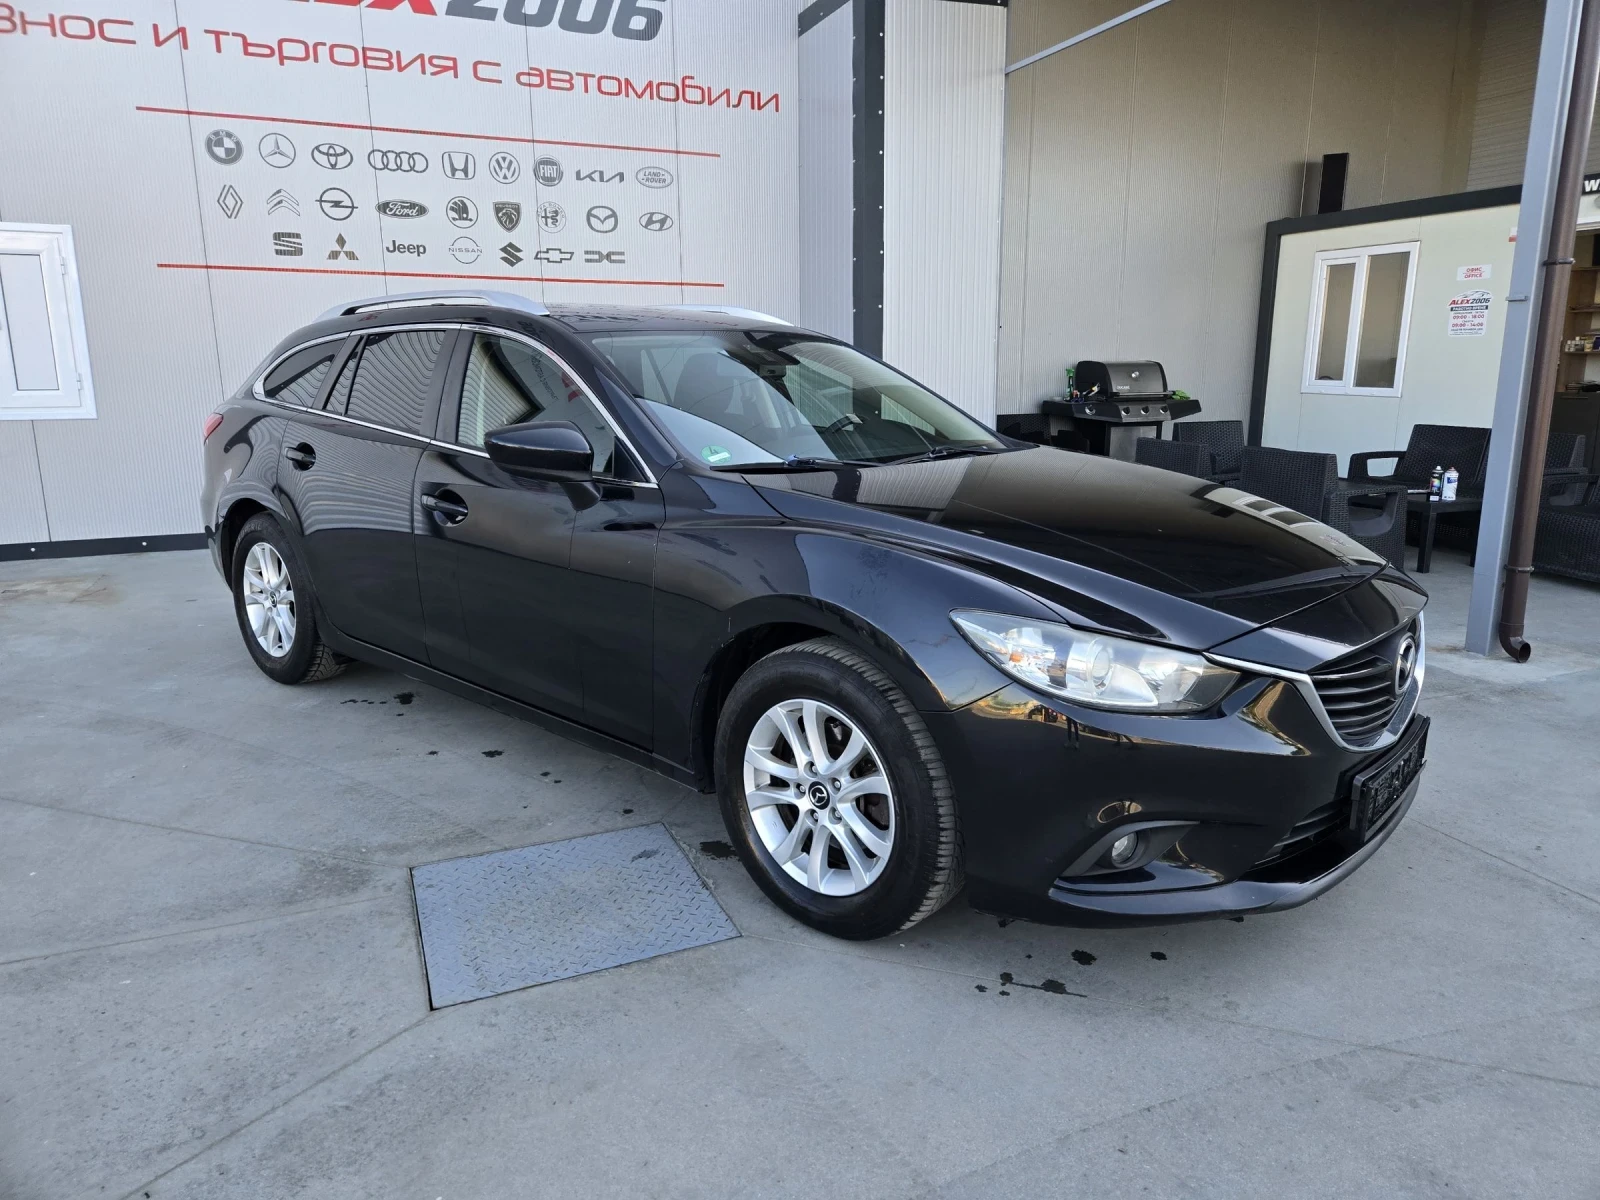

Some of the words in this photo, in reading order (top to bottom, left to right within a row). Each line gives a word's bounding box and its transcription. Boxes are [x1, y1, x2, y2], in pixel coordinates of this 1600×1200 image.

[152, 22, 189, 51] и
[203, 28, 459, 79] търговия
[472, 59, 503, 84] с
[515, 66, 780, 113] автомобили
[539, 164, 558, 178] FIAT
[385, 201, 419, 216] Ford
[385, 239, 427, 257] Jeep
